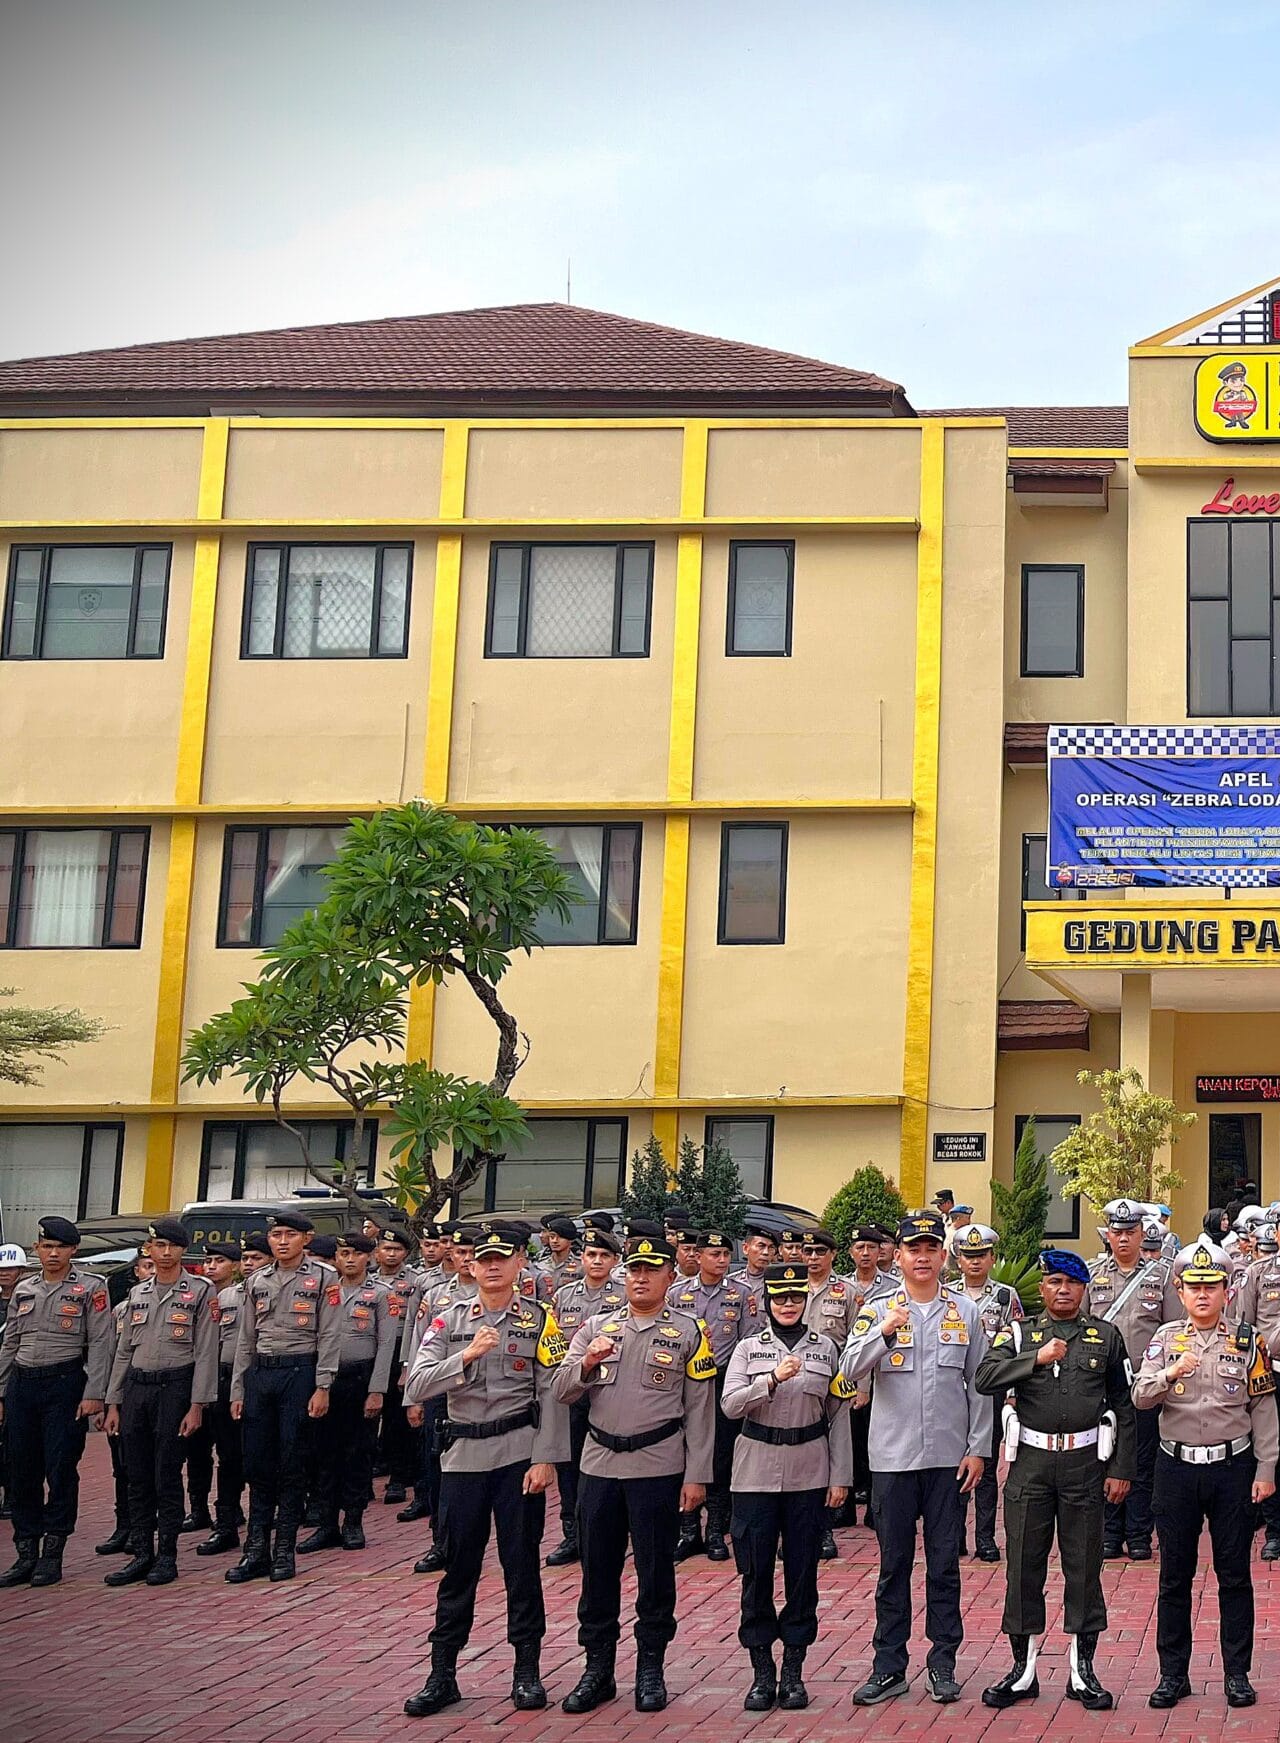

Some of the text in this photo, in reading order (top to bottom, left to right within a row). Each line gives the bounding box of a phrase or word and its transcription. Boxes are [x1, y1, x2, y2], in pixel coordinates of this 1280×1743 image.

[1201, 475, 1280, 515] Love
[1219, 772, 1272, 787] APEL
[1076, 793, 1157, 808] OPERASI
[1064, 919, 1218, 954] GEDUNG
[1140, 1283, 1161, 1291] POLRI
[508, 1330, 539, 1340] POLRI
[652, 1338, 682, 1350] POLRI
[806, 1352, 831, 1362] POLRI
[1219, 1354, 1246, 1364] POLRI
